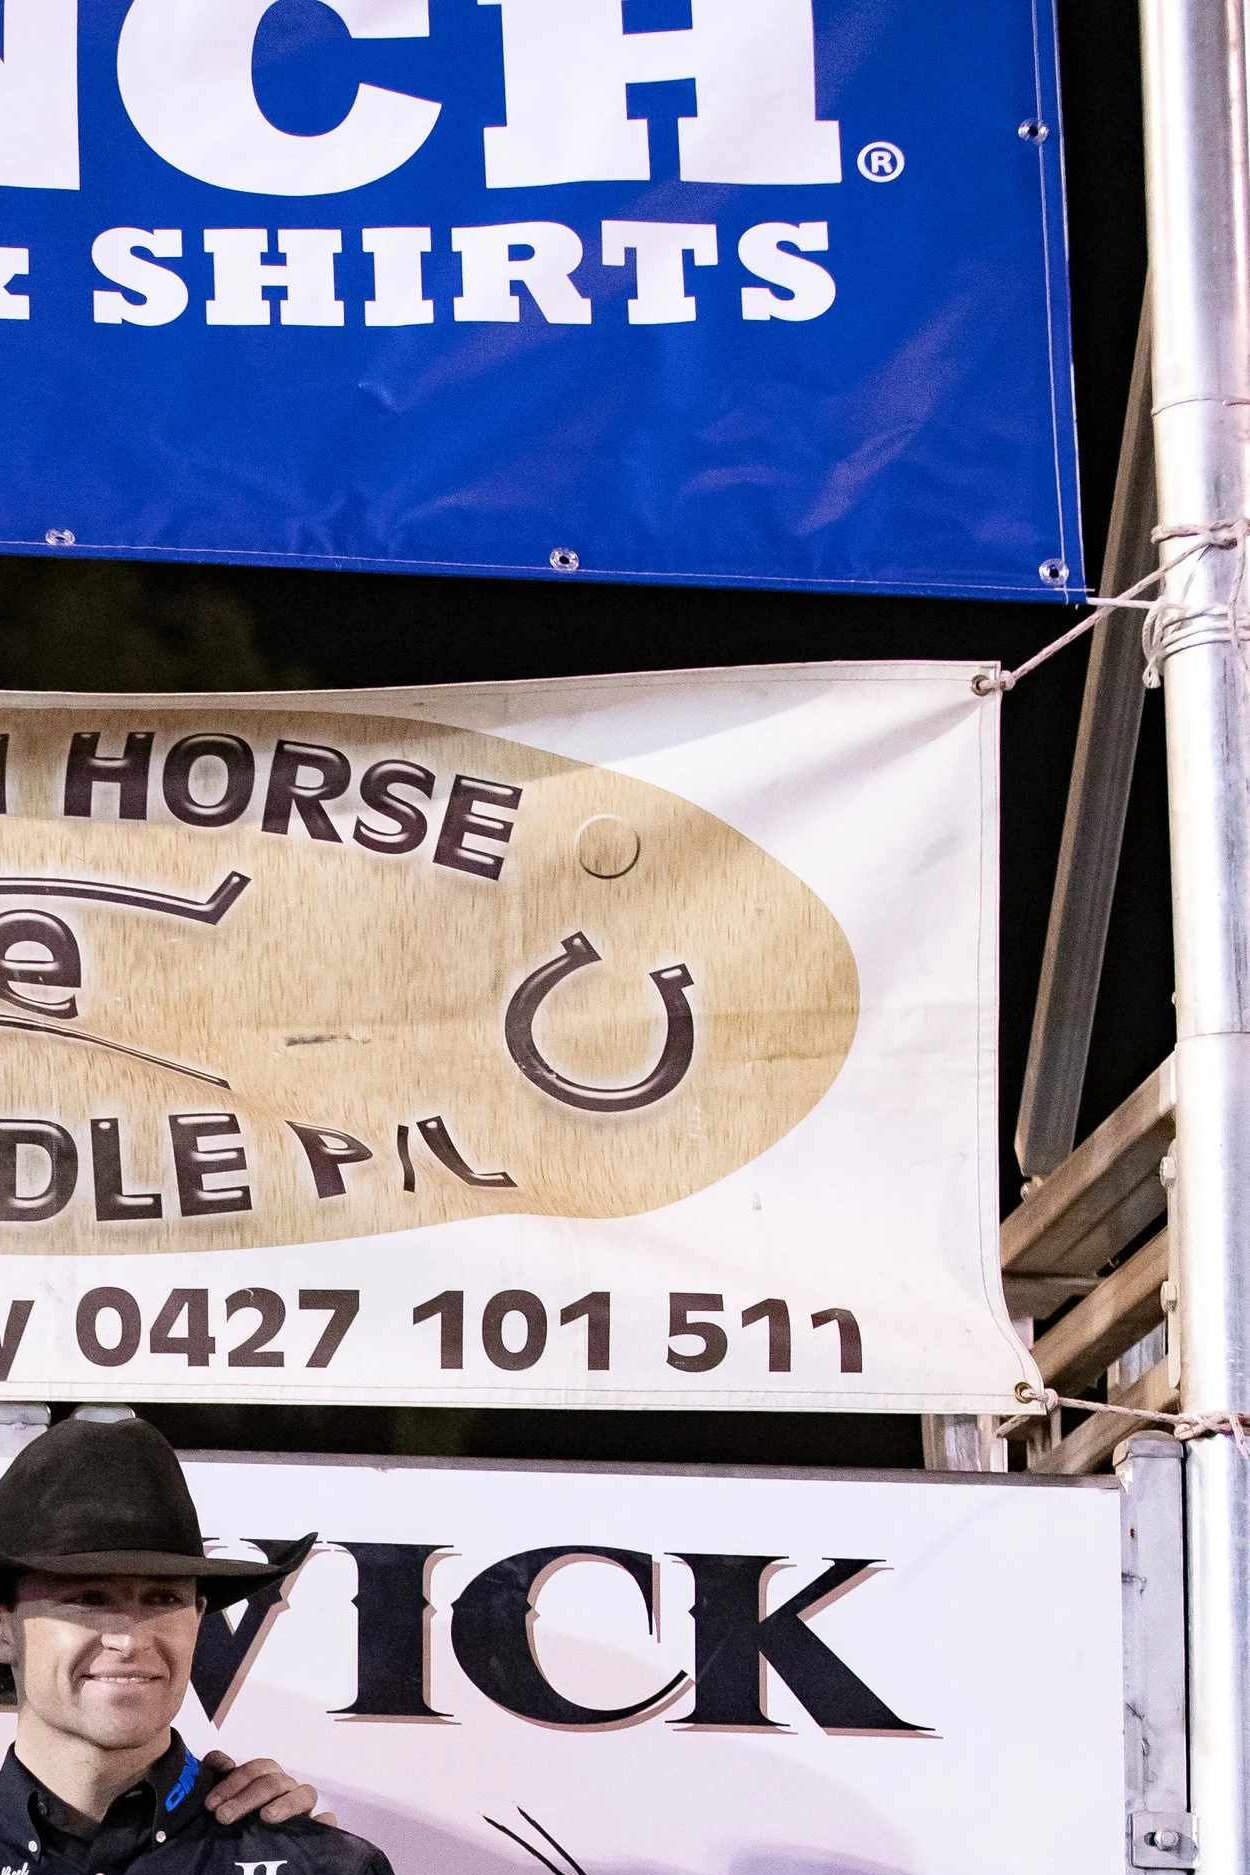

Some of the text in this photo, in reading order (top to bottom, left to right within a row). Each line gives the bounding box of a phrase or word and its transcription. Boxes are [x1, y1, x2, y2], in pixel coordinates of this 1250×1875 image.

[90, 219, 837, 327] SHIRTS
[62, 730, 524, 882] HORSE
[283, 1115, 518, 1199] P/L
[75, 1286, 361, 1370] 0427
[411, 1288, 613, 1372] 101
[665, 1292, 864, 1374] 511
